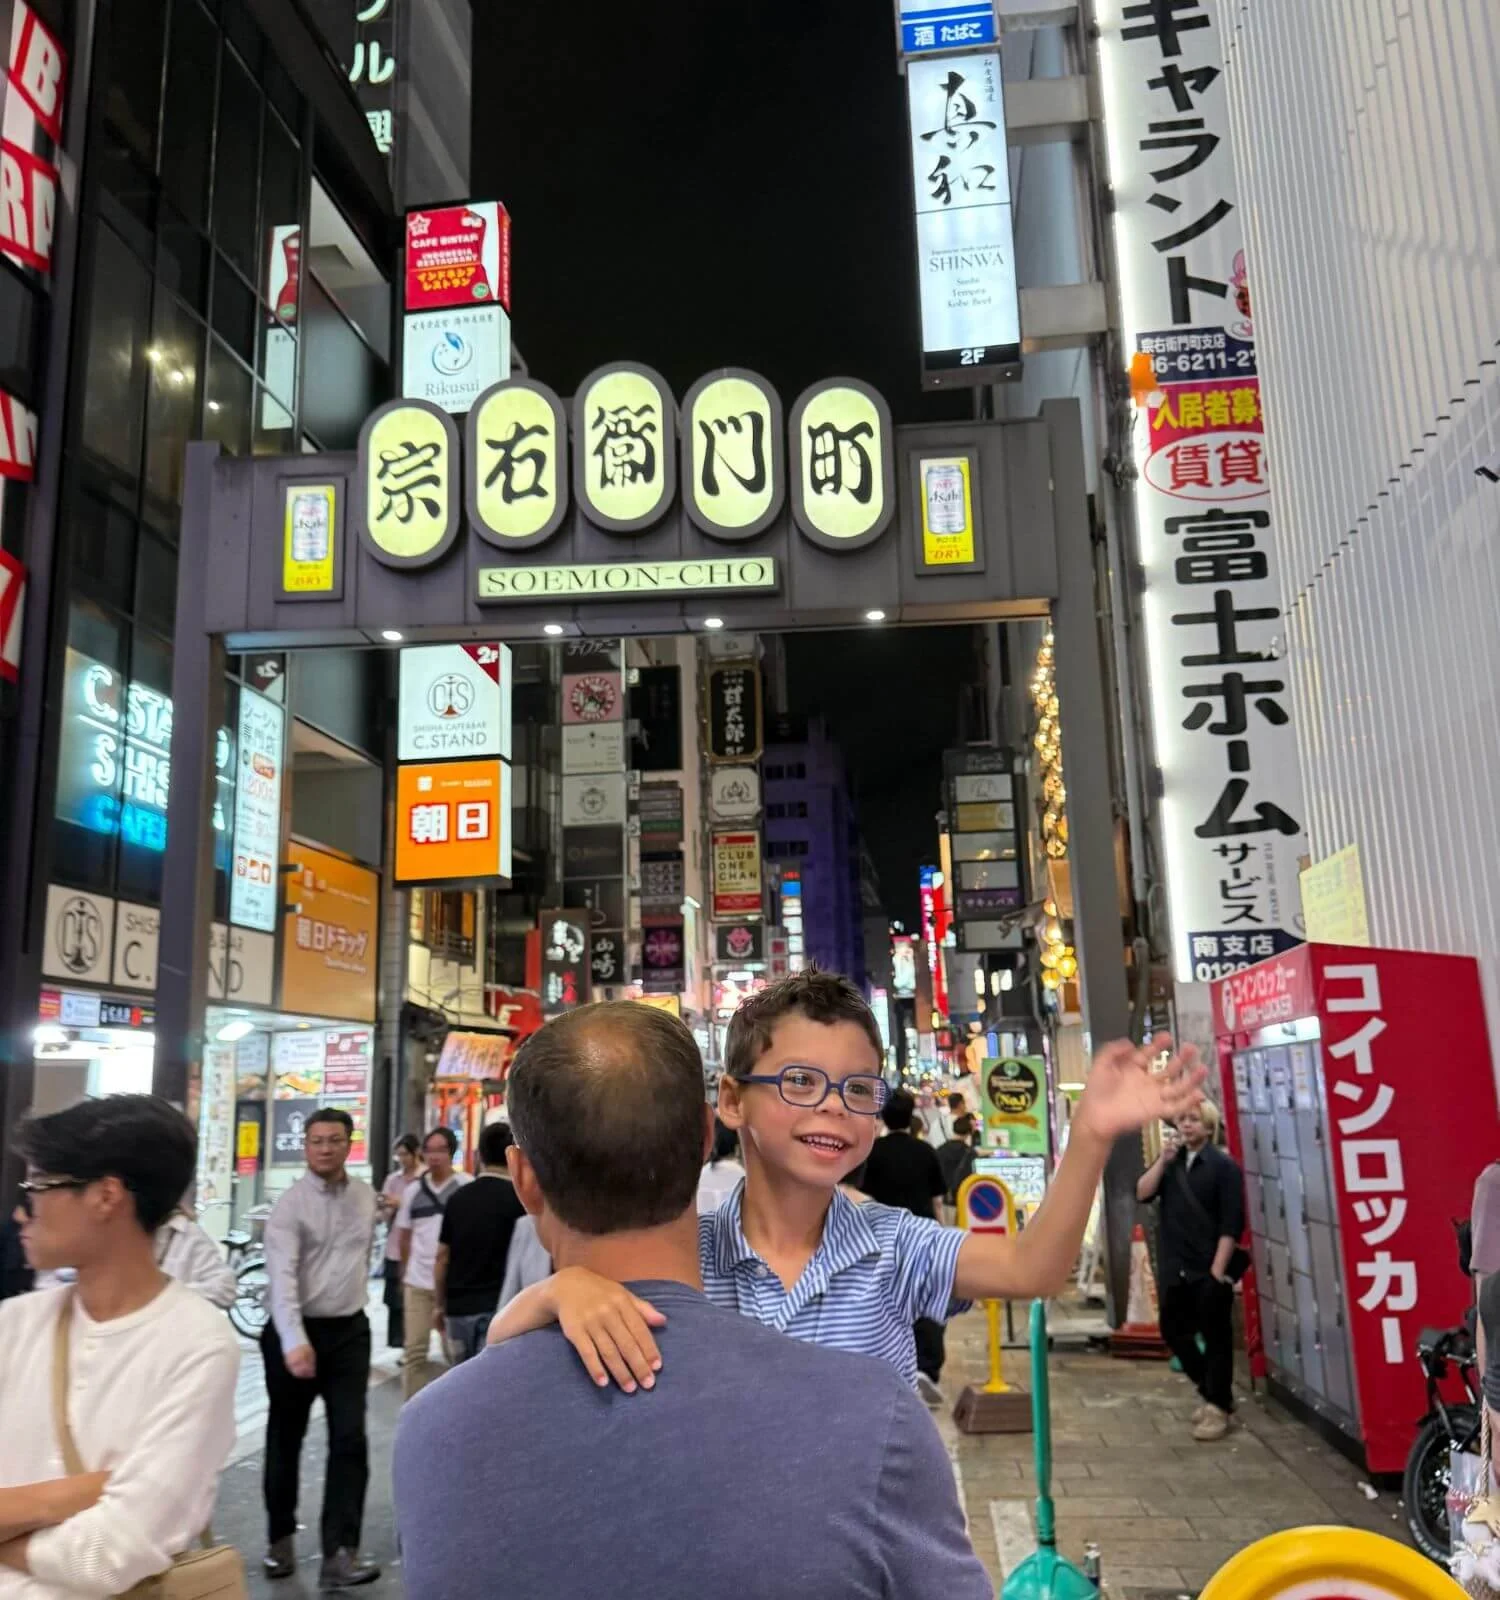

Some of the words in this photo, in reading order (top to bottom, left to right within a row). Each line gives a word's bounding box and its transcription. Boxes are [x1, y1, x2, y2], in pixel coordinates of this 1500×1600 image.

[914, 26, 936, 46] 酒
[940, 22, 984, 42] たばこ
[411, 237, 438, 249] CAFE
[929, 251, 1004, 273] SHINWA
[960, 348, 985, 365] 2F
[1150, 350, 1257, 374] 6-6211-2
[425, 379, 481, 396] Rikusui
[1152, 388, 1263, 430] 入居者募
[486, 560, 766, 594] SOEMON-CHO
[412, 731, 488, 750] C.STAND
[411, 801, 489, 843] 朝日
[718, 851, 755, 860] CLUB
[718, 861, 745, 870] ONE
[718, 871, 758, 880] CHAN
[1194, 935, 1275, 958] 南支店
[1323, 963, 1420, 1365] コインロッカー
